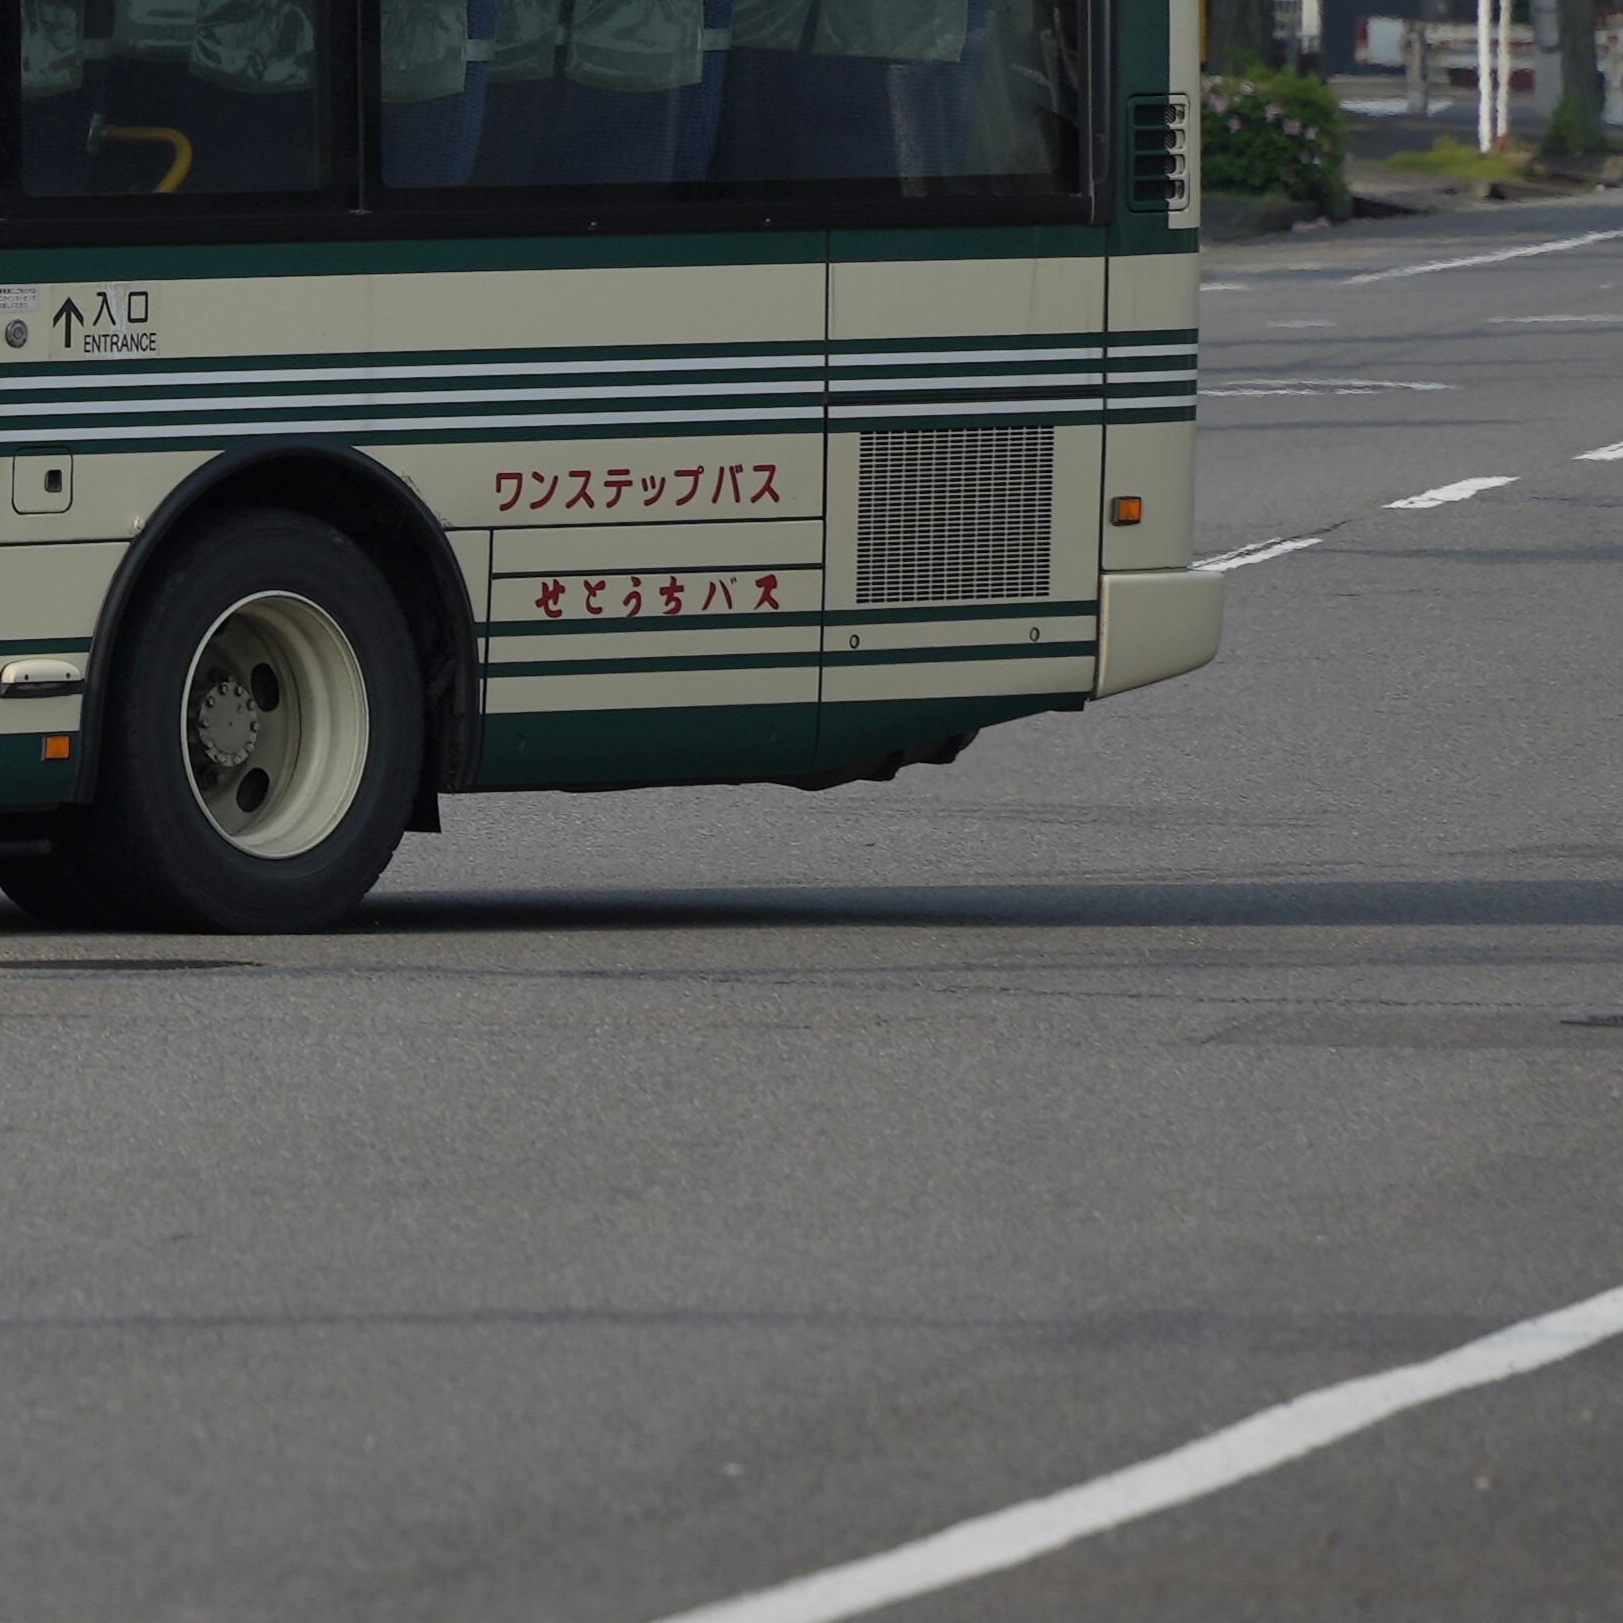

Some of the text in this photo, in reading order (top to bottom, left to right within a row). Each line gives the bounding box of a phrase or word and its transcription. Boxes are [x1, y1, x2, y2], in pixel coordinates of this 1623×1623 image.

[92, 291, 149, 327] 入口
[83, 332, 157, 353] ENTRANCE
[496, 464, 780, 512] ワンステップバス
[535, 574, 780, 618] せとうちバス
